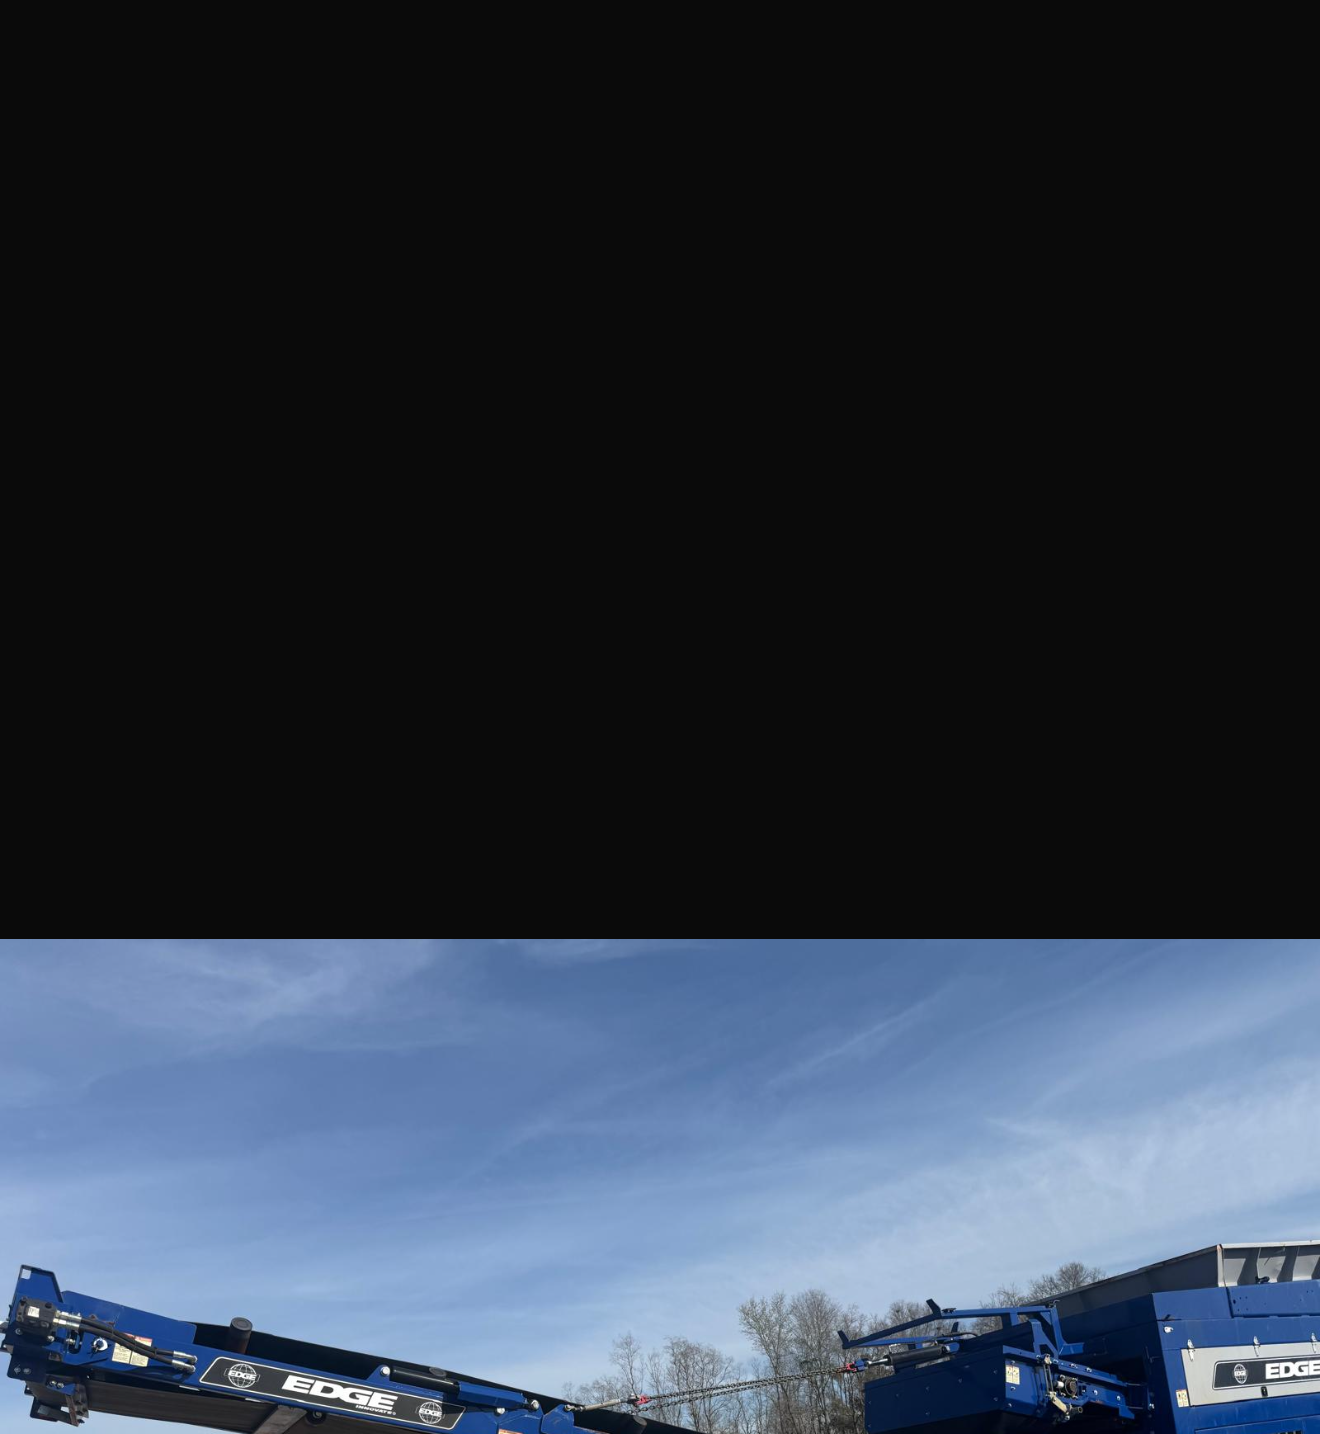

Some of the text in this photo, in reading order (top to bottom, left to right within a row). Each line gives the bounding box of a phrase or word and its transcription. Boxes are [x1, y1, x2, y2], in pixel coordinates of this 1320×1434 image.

[228, 1370, 257, 1381] EDGE
[1265, 1360, 1320, 1380] EDGE
[281, 1374, 398, 1411] EDGE
[419, 1407, 443, 1418] EDGE
